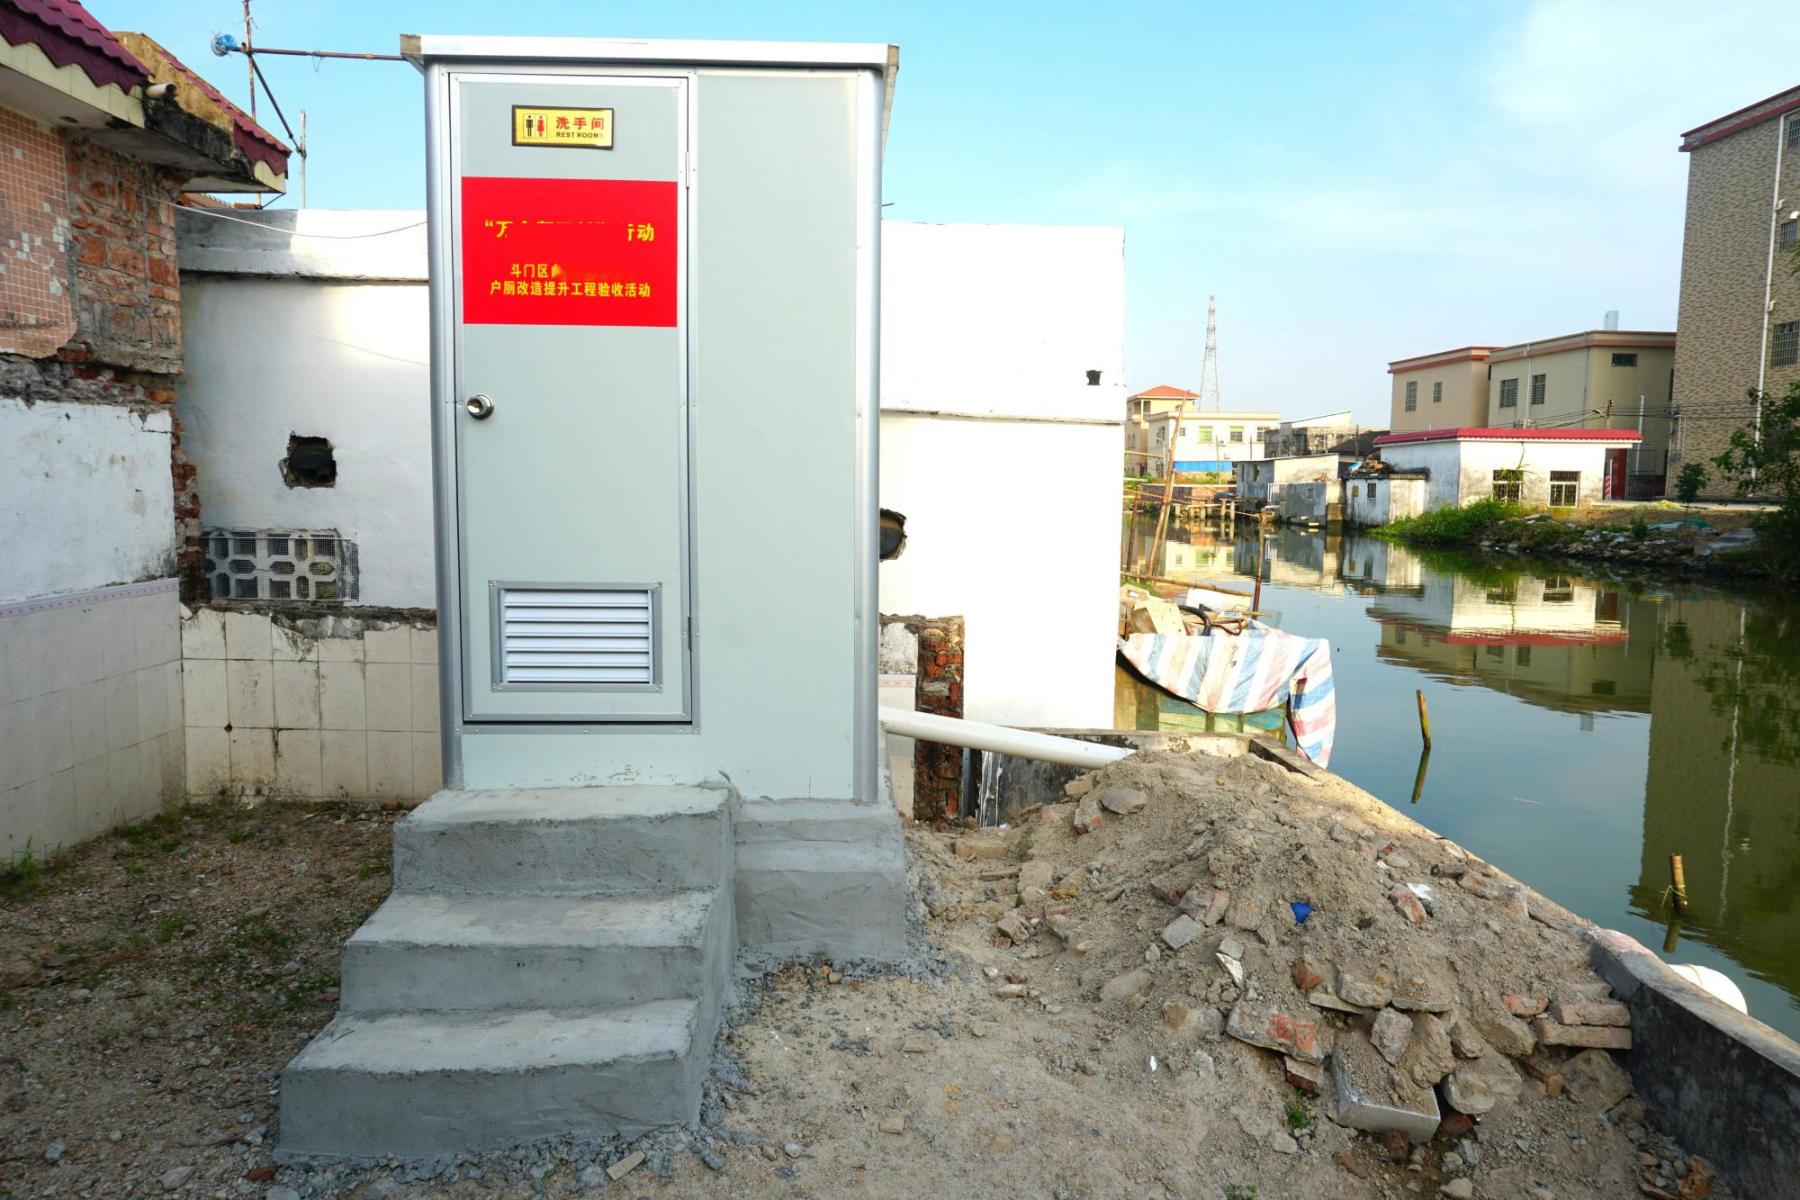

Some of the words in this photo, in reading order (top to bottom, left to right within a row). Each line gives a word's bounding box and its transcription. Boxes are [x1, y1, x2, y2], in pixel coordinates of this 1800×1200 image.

[556, 116, 604, 130] 洗手间
[490, 280, 651, 297] 户厕改造提升工程验收活动
